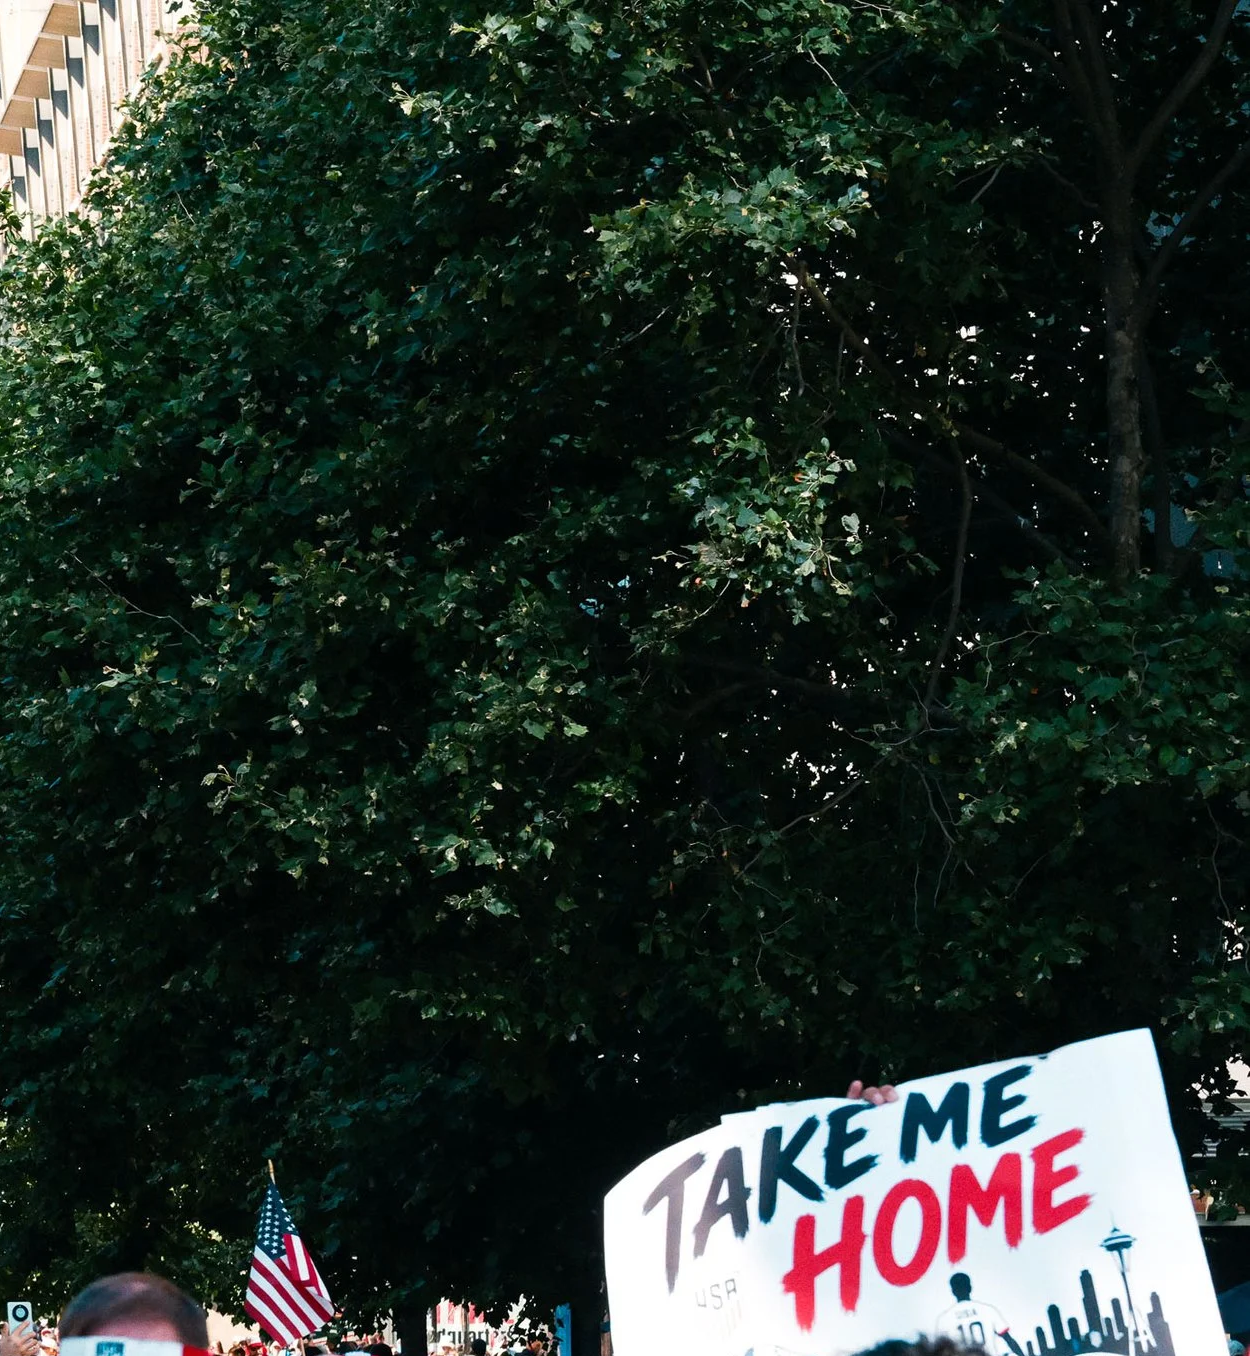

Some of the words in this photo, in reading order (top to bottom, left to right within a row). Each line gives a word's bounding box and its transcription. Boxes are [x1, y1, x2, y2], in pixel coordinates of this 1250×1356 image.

[642, 1103, 880, 1296] TAKE
[899, 1064, 1038, 1165] ME
[782, 1127, 1095, 1333] HOME
[694, 1278, 738, 1311] USA
[956, 1320, 986, 1347] 10
